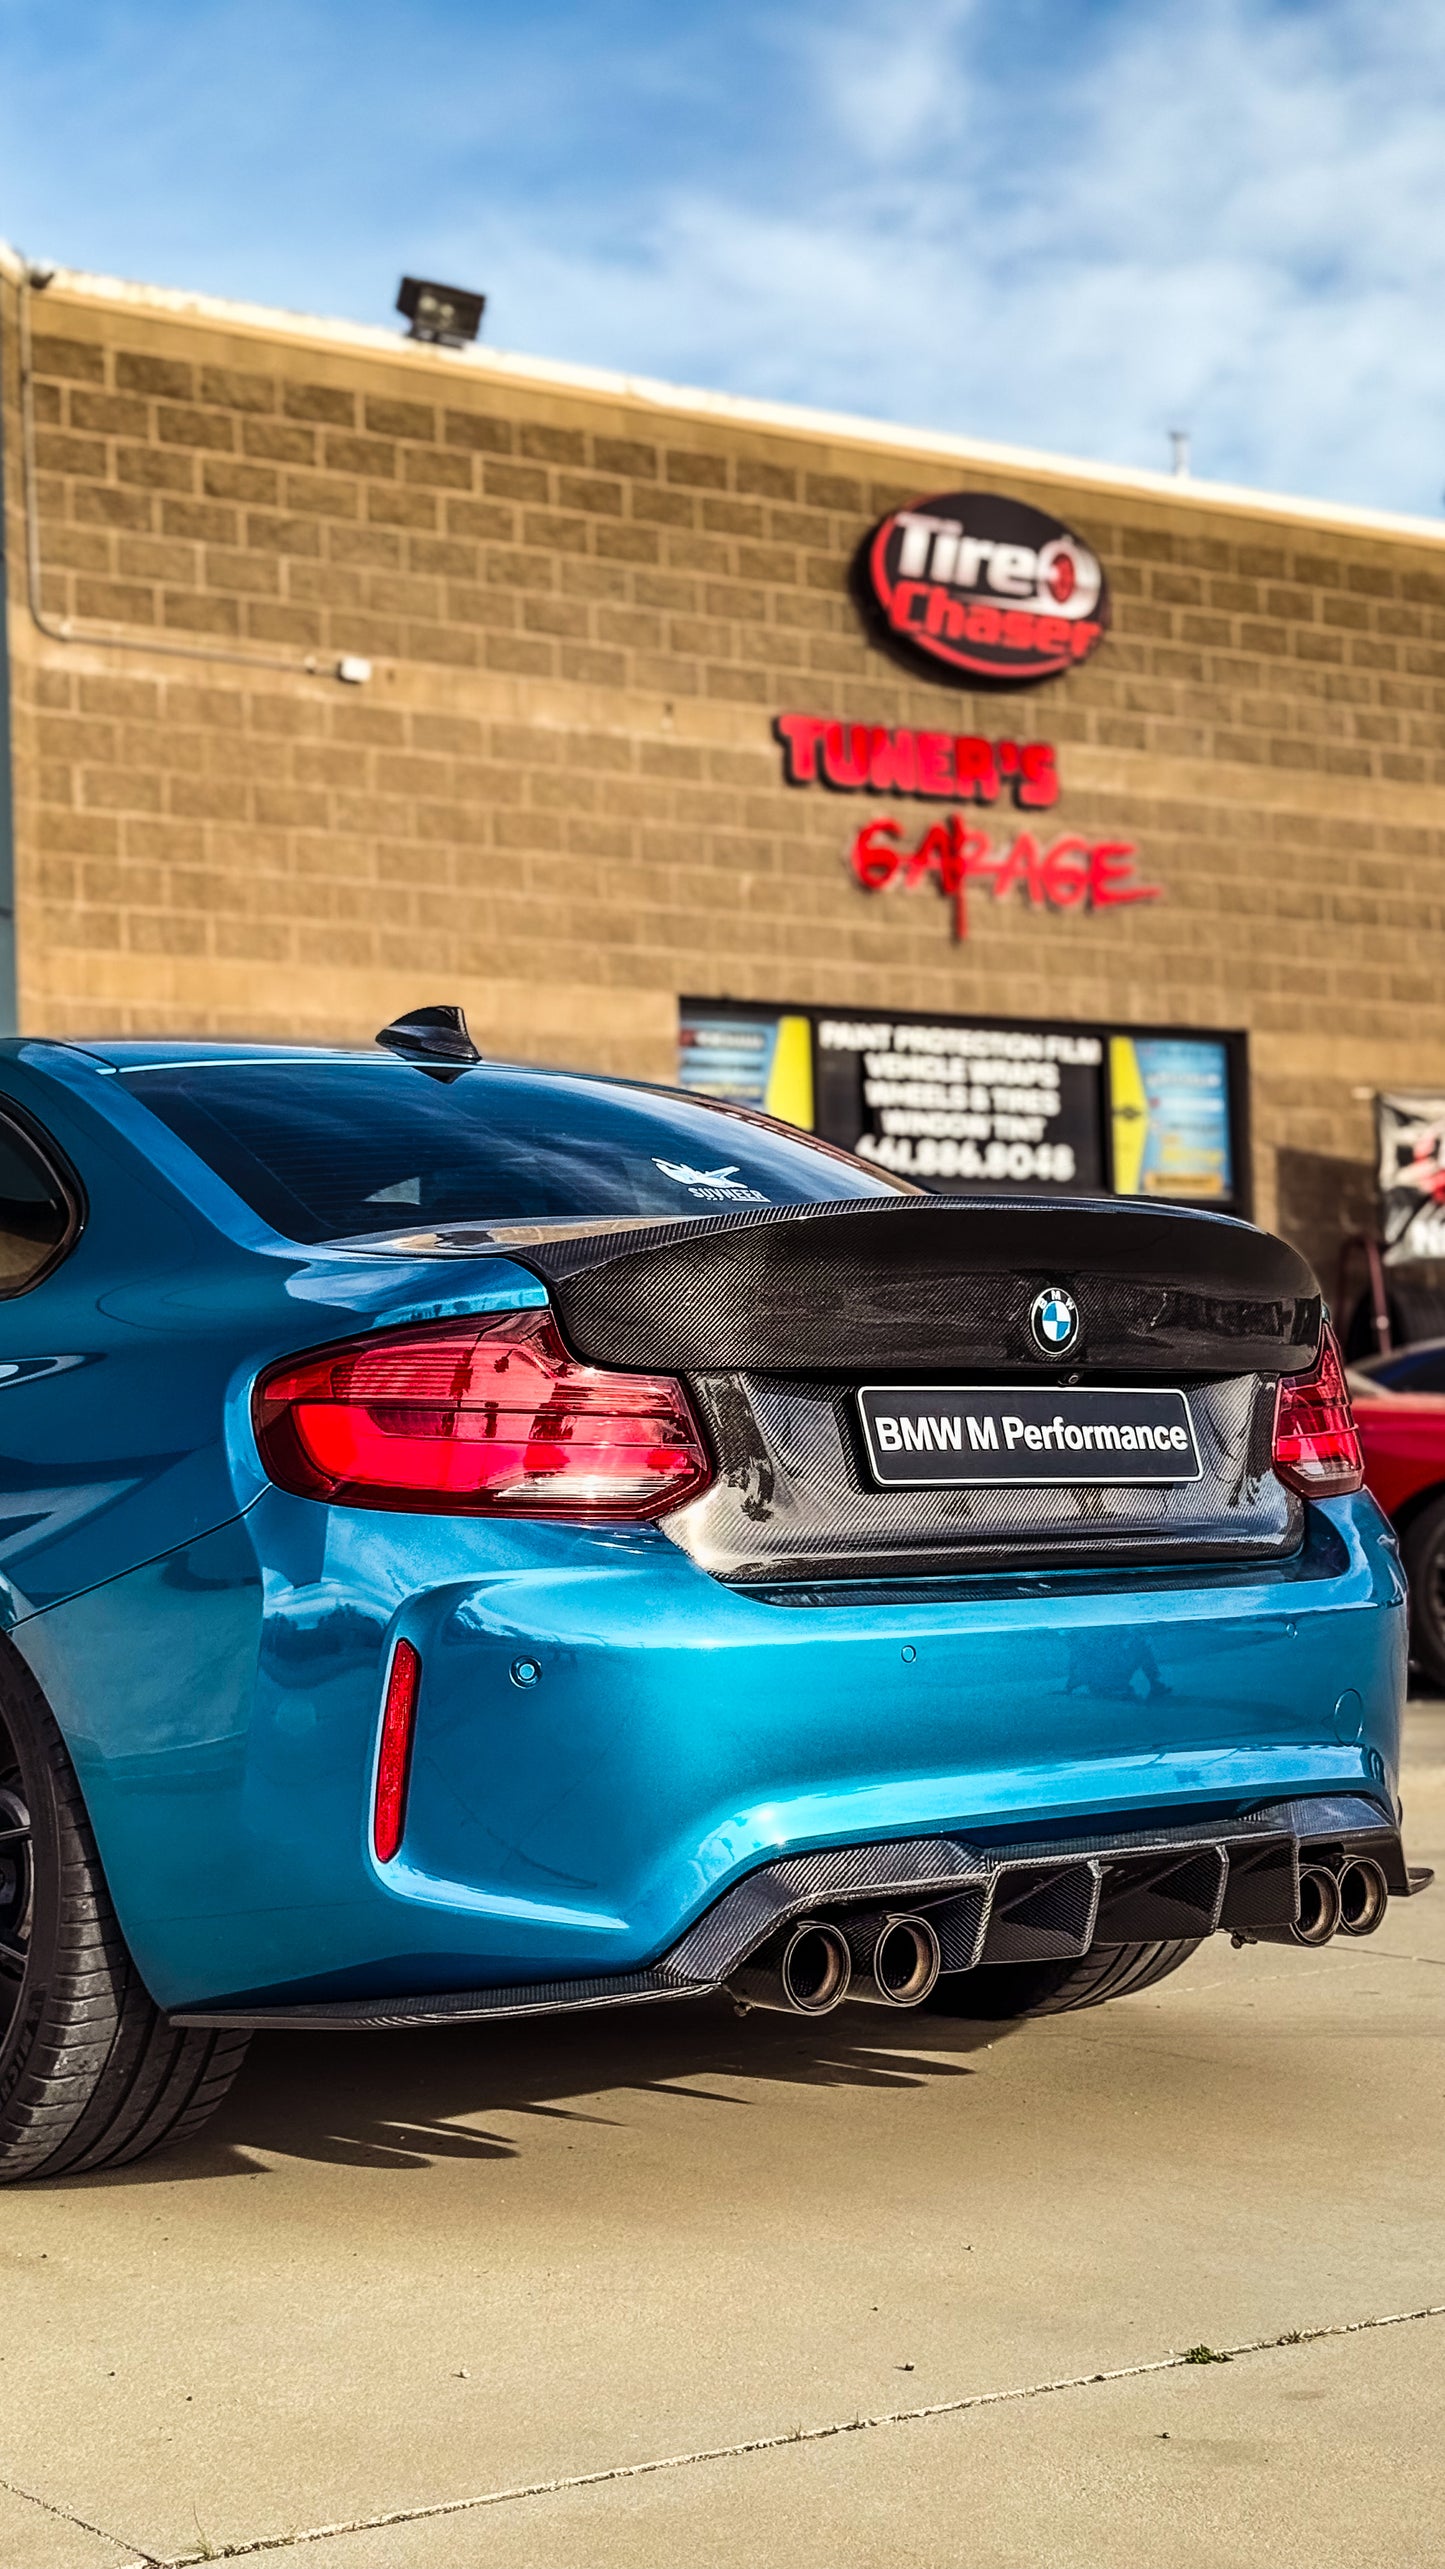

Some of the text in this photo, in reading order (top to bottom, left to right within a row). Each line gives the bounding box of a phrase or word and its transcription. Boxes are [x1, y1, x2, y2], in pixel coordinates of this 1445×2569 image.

[896, 512, 1038, 596] Tire
[887, 580, 1101, 657] Chaser
[778, 713, 1060, 807] TUNER'S
[850, 812, 1162, 942] GARAGE
[819, 1020, 1102, 1065] PAINT PROTECTION FILM
[864, 1052, 1060, 1088] VEHICLE WRAPS
[864, 1079, 1061, 1116] WHEELS & TIRES
[881, 1108, 1047, 1142] WINDOW TINT
[1039, 1290, 1076, 1310] BMW
[875, 1415, 1188, 1451] BMW M Performance
